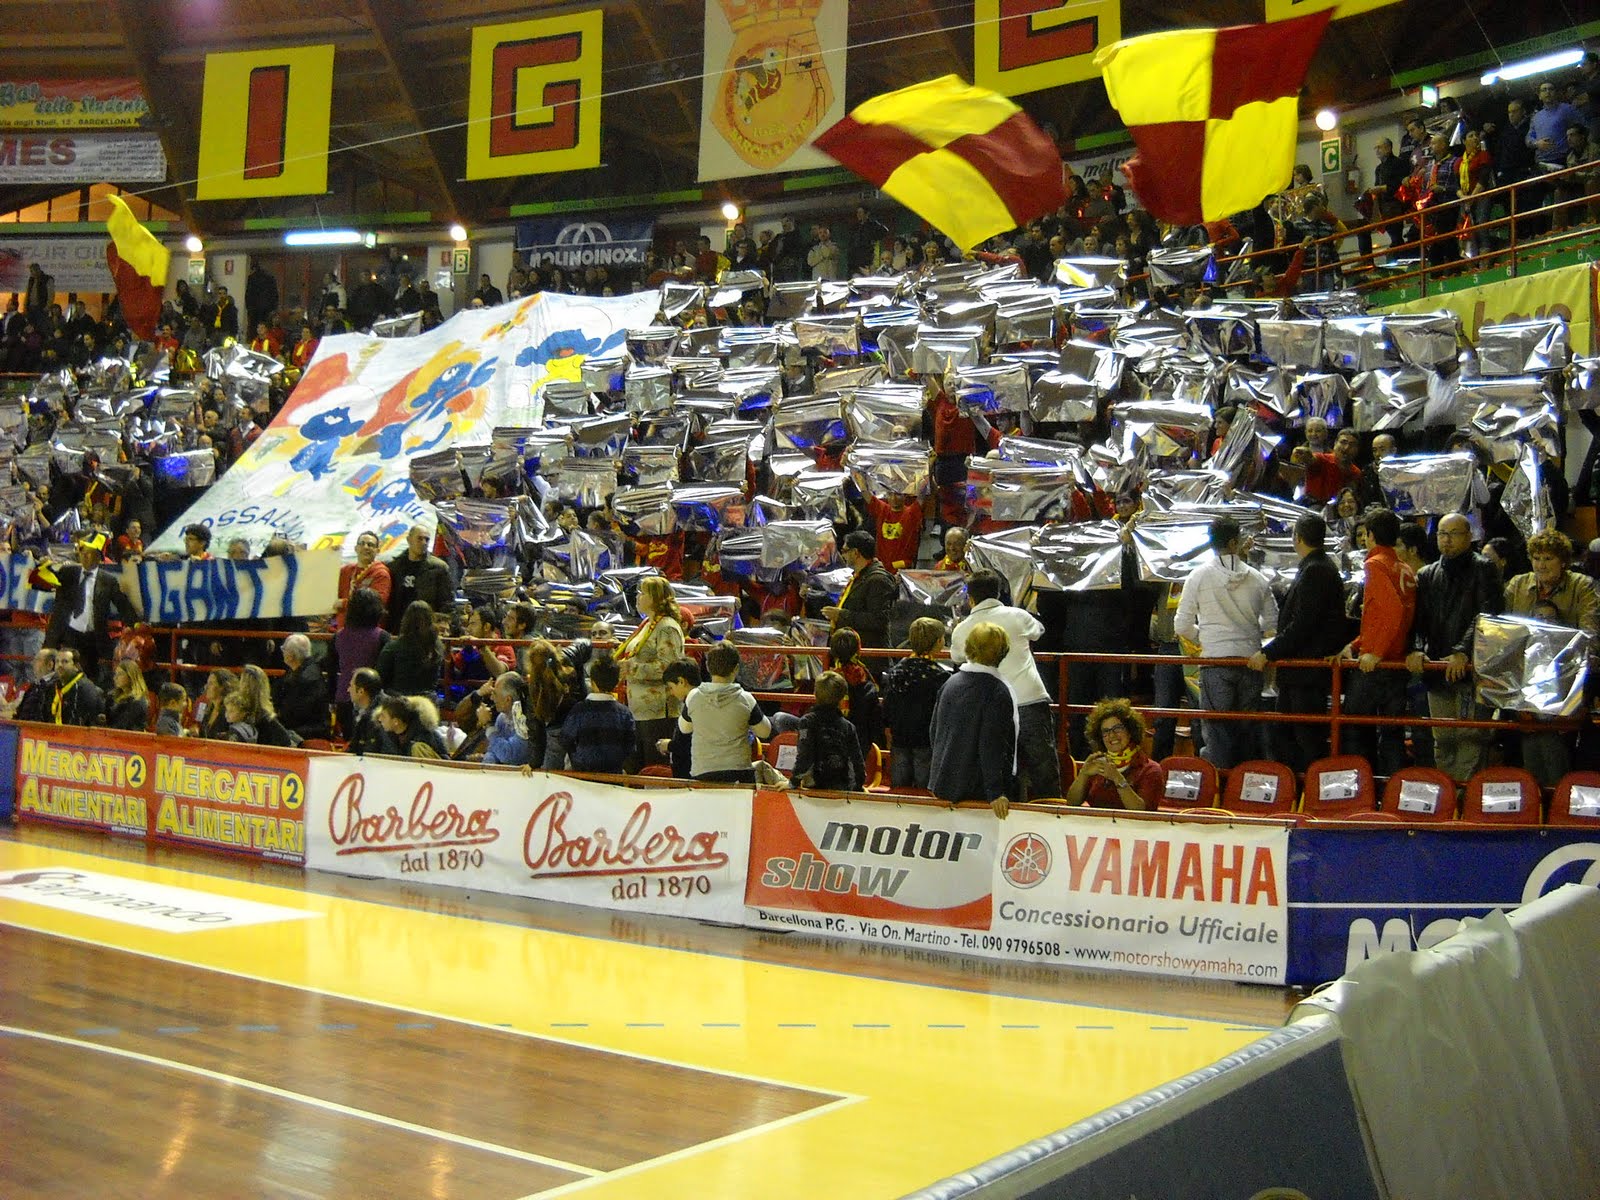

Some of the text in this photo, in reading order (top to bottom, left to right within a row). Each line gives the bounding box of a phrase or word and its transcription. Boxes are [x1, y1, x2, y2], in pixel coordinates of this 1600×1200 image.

[490, 31, 583, 158] G
[79, 117, 132, 126] BARCELLONA
[1324, 147, 1337, 170] C
[456, 254, 466, 271] B
[21, 739, 126, 788] MERCATI
[155, 754, 279, 808] MERCATI
[21, 777, 148, 829] ALIMENTARI
[157, 795, 304, 853] ALIMENTARI
[329, 772, 500, 855] Barbera
[523, 791, 729, 879] Barbera
[820, 821, 982, 862] motor
[400, 848, 484, 873] dal 1870
[761, 853, 910, 899] show
[1065, 834, 1279, 907] YAMAHA
[612, 875, 711, 900] dal 1870
[759, 910, 822, 930] Barcellona
[860, 921, 877, 938] Via
[882, 924, 902, 941] On.
[904, 928, 950, 946] Martino
[961, 933, 979, 949] Tel.
[982, 935, 1002, 951] 090
[1005, 937, 1061, 957] 9796508
[1074, 948, 1278, 978] www.motorshowyamaha.com
[999, 900, 1279, 944] Concessionario Ufficiale
